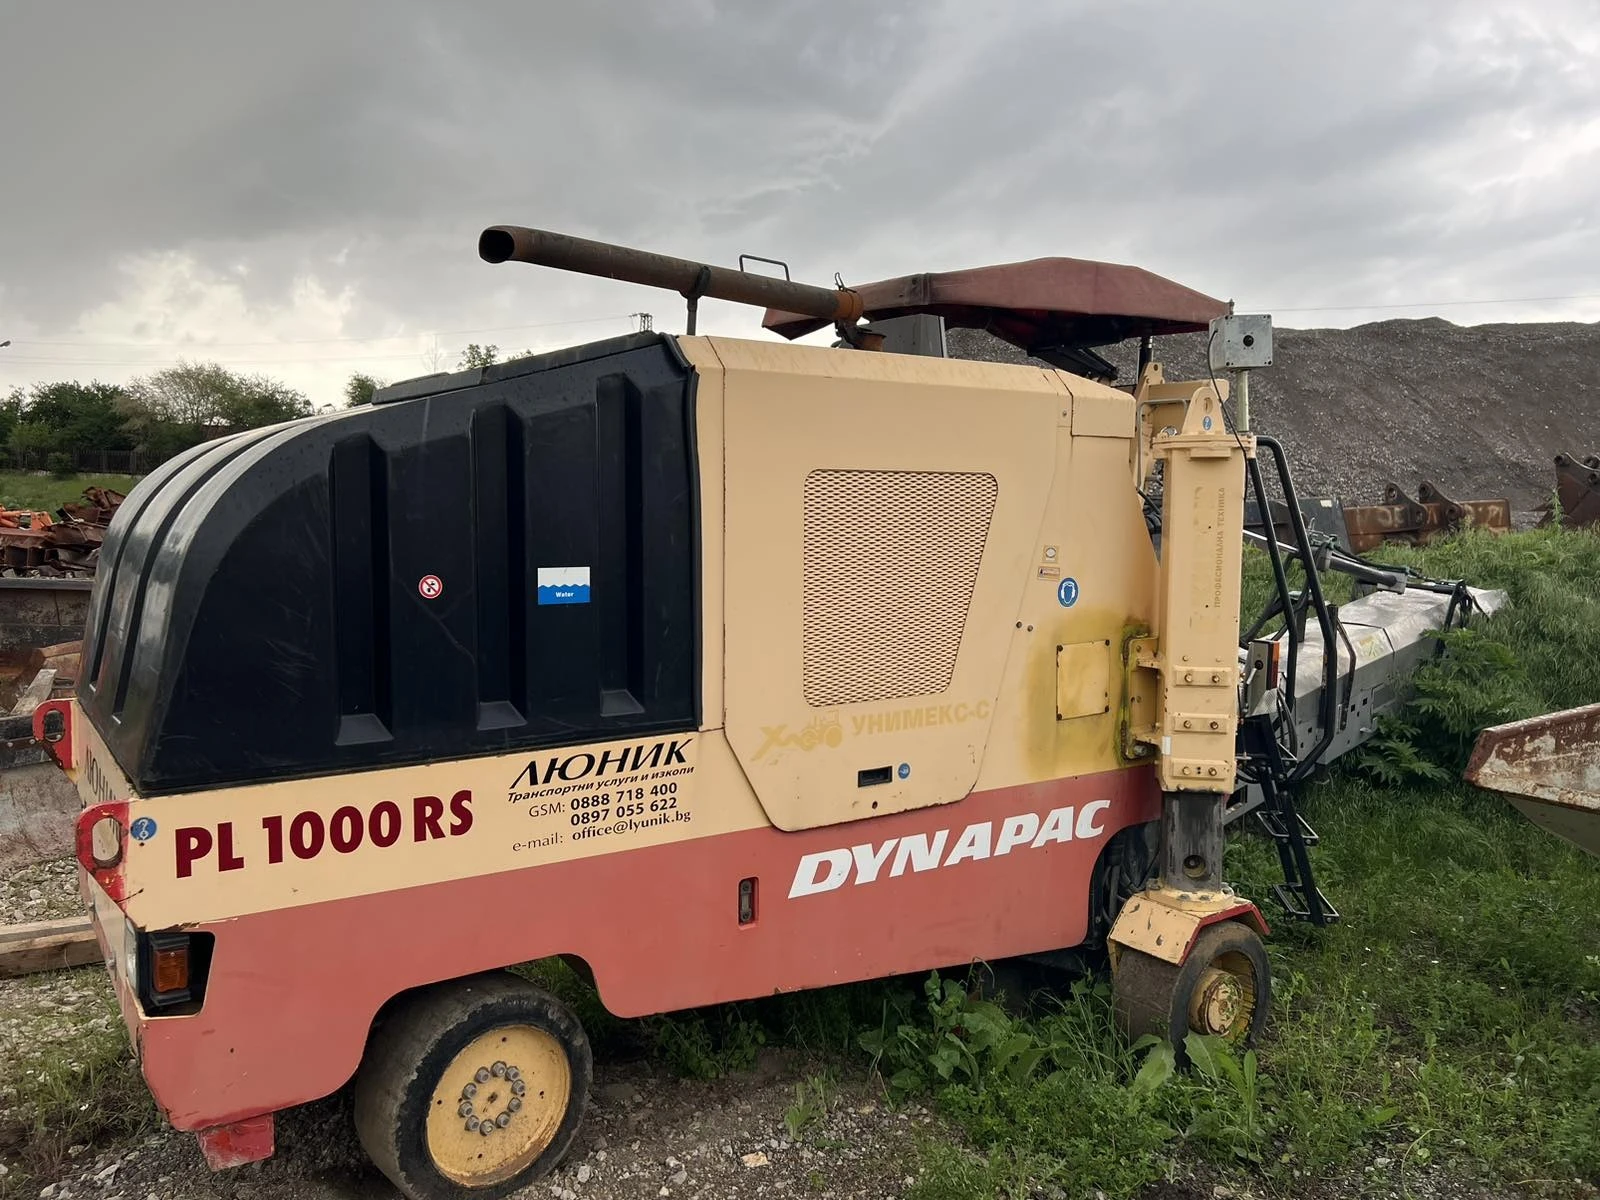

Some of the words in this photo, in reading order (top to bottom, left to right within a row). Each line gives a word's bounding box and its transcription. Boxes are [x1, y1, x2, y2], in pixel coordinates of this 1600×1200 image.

[851, 700, 990, 736] УНИМЕКС-С
[509, 739, 693, 789] ЛЮНИК
[508, 782, 594, 804] Транспортни
[596, 776, 638, 791] услуги
[640, 773, 648, 781] и
[651, 766, 695, 780] изкопи
[528, 802, 565, 817] GSM:
[571, 793, 610, 811] 0888
[617, 787, 644, 803] 718
[650, 782, 677, 797] 400
[512, 833, 563, 852] e-mail:
[572, 810, 691, 841] office@lyunik.bg
[571, 808, 610, 826] 0897
[616, 803, 644, 818] 055
[650, 797, 677, 812] 622
[175, 822, 245, 878] PL
[262, 800, 401, 864] 1000
[413, 790, 473, 842] RS
[787, 800, 1111, 899] DYNAPAC
